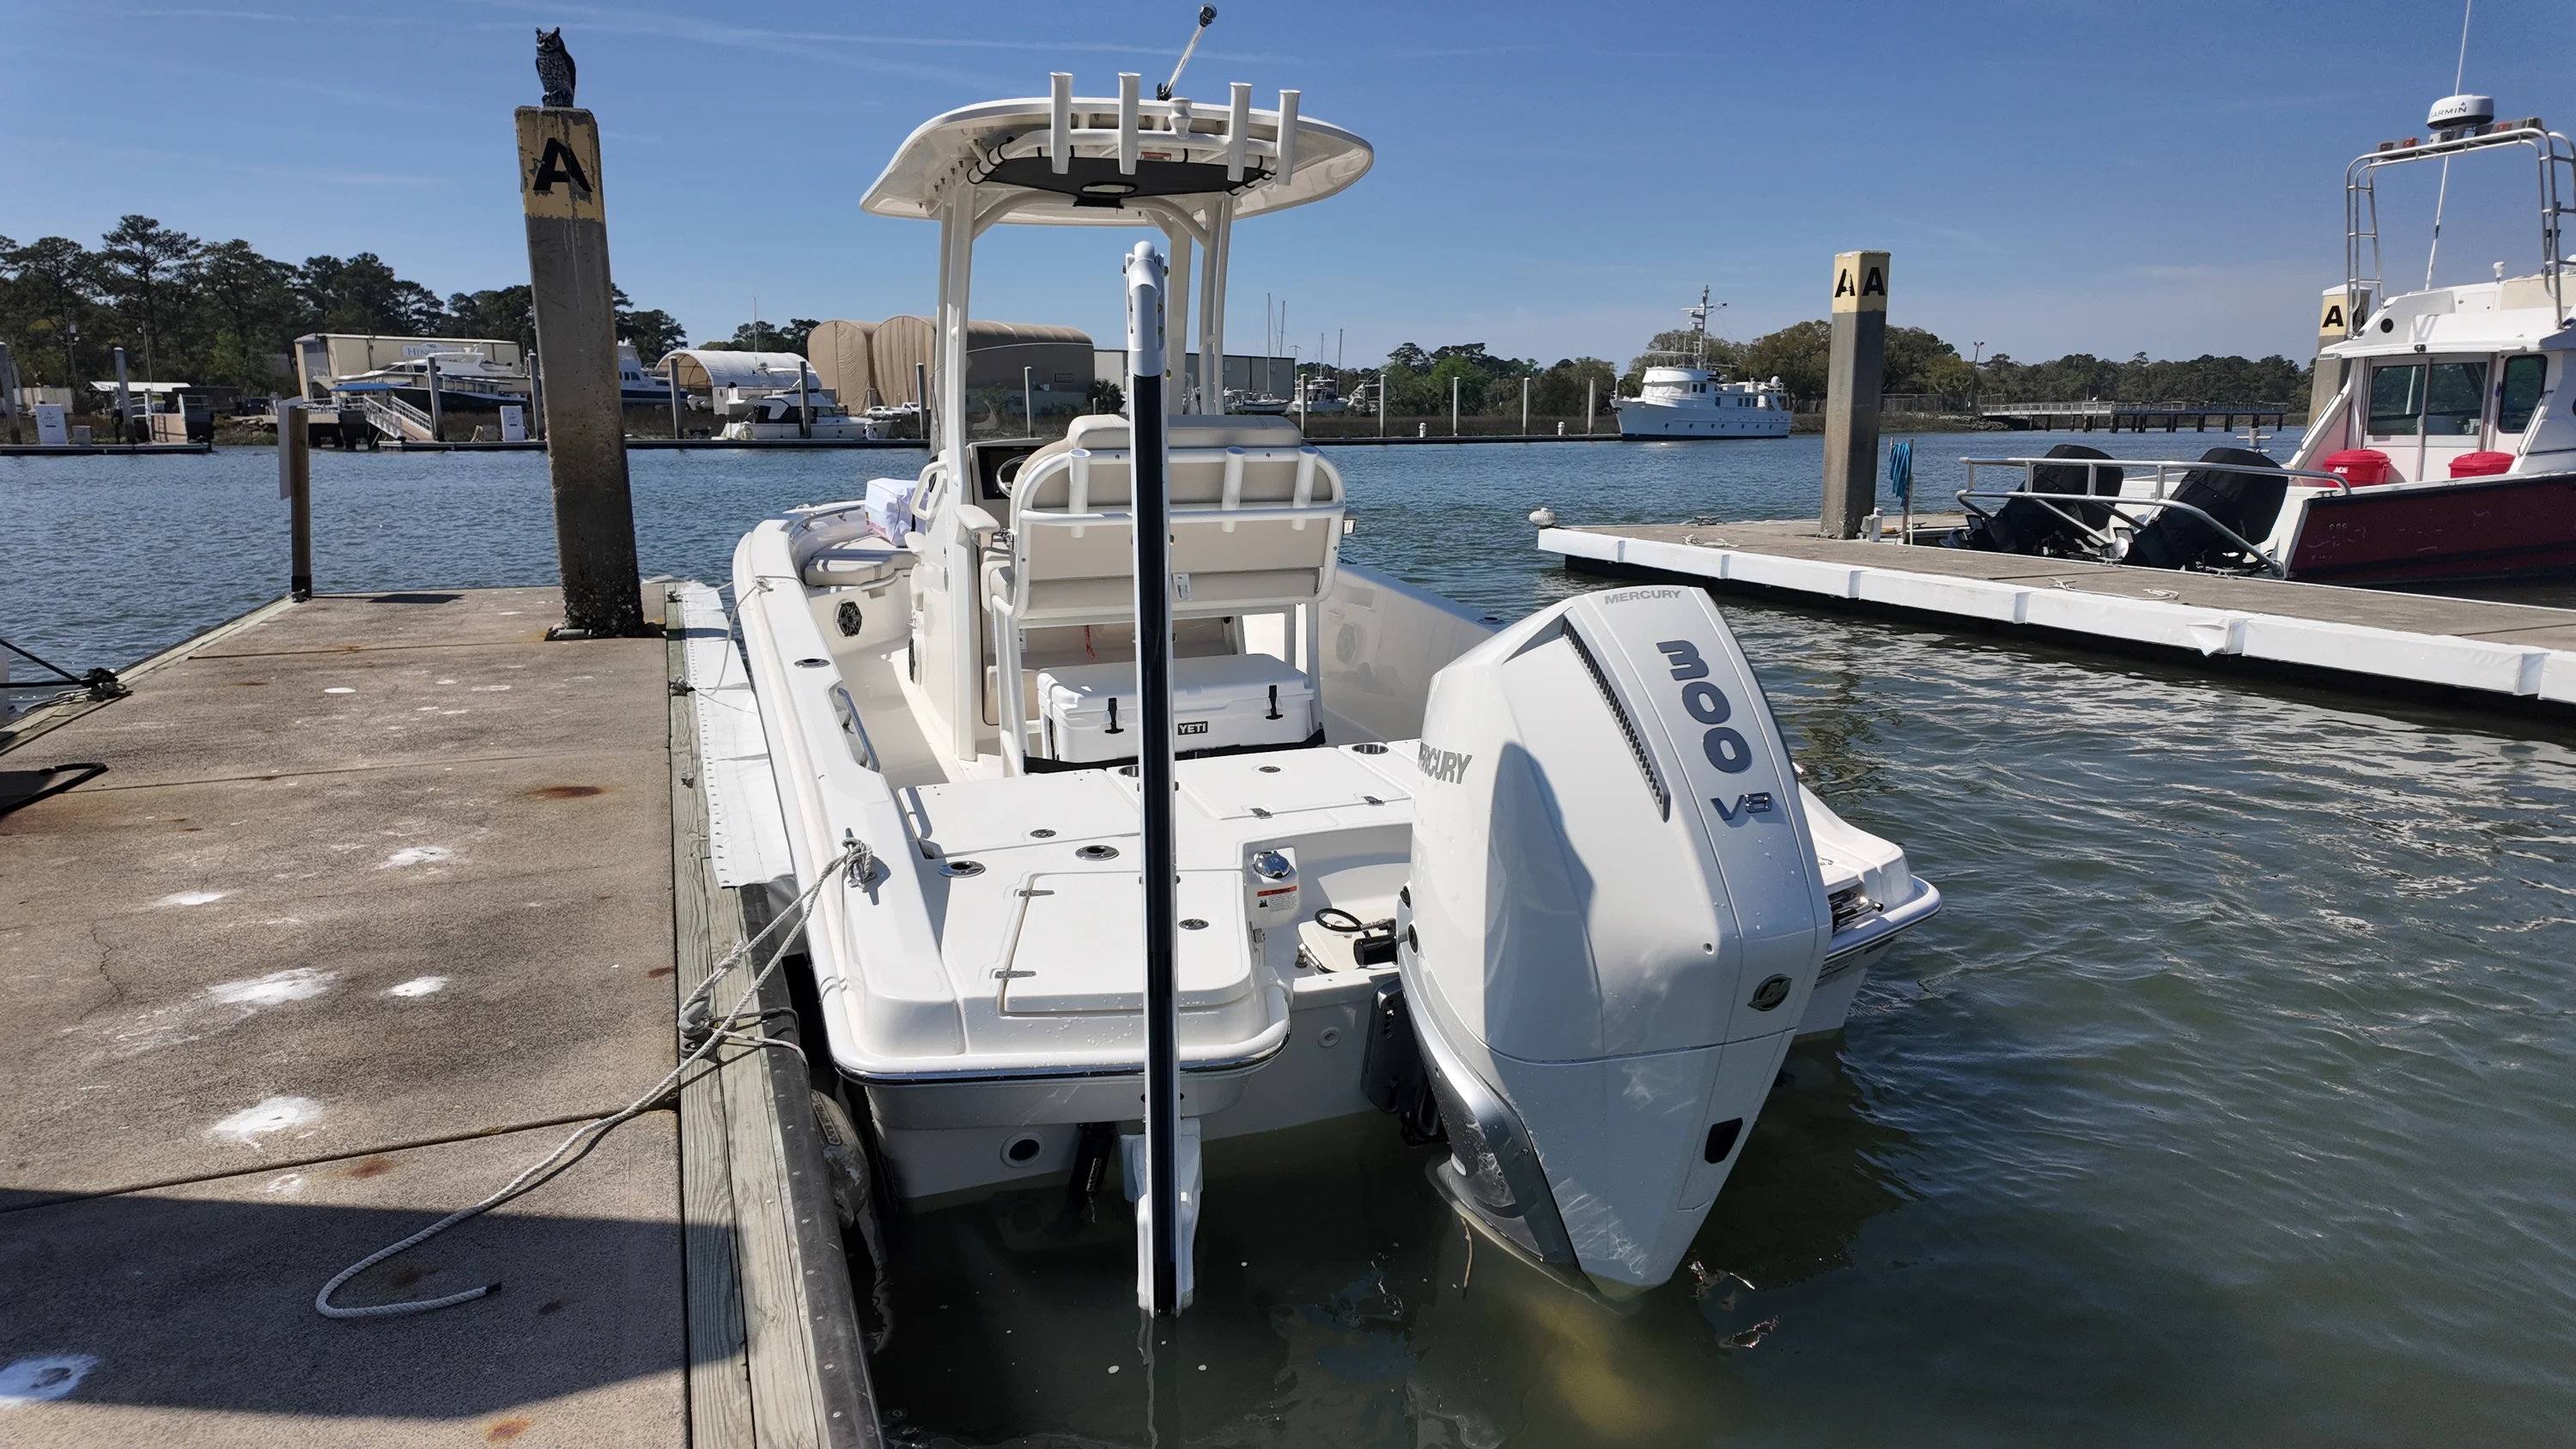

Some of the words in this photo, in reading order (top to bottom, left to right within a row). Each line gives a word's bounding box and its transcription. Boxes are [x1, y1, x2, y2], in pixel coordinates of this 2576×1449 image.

[532, 137, 592, 192] A
[1834, 268, 1856, 298] A
[1861, 267, 1886, 296] A
[2322, 305, 2344, 328] A
[1604, 590, 1681, 604] MERCURY
[1656, 640, 1753, 773] 300
[1179, 723, 1206, 734] YETI
[1419, 742, 1473, 785] ERCURY
[1710, 791, 1771, 821] V8
